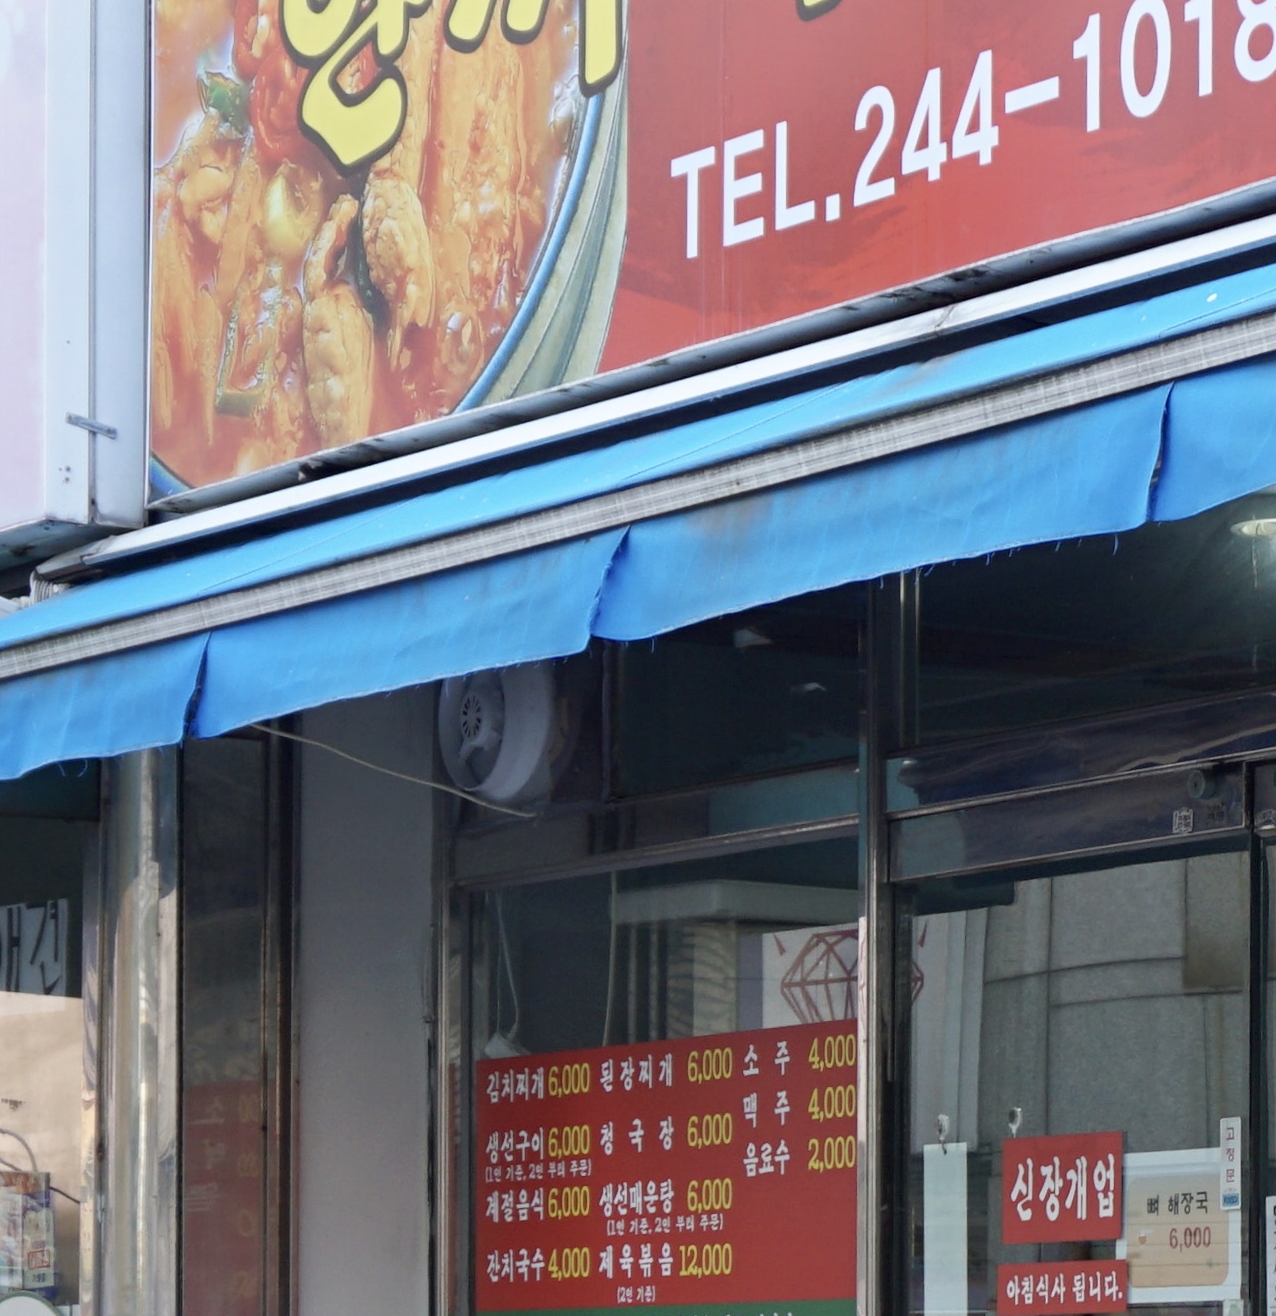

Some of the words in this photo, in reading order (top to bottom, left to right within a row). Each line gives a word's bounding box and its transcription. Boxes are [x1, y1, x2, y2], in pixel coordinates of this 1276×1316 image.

[807, 1033, 856, 1073] 4,000
[486, 1067, 544, 1103] 김치찌개
[547, 1062, 591, 1097] 6,000
[599, 1052, 673, 1093] 된장찌개
[687, 1046, 733, 1084] 6,000
[807, 1084, 856, 1123] 4,000
[485, 1126, 545, 1164] 생선구이
[547, 1124, 591, 1159] 6,000
[687, 1112, 733, 1149] 6,000
[742, 1138, 791, 1177] 음료수
[807, 1135, 856, 1174] 2,000
[1225, 1126, 1236, 1184] 고정문
[485, 1187, 545, 1223] 계절음식
[547, 1185, 591, 1220] 6,000
[598, 1178, 675, 1217] 생선매운탕
[686, 1177, 733, 1214] 6,000
[1010, 1152, 1117, 1222] 신장개업
[1146, 1194, 1160, 1217] 뼈
[1167, 1190, 1210, 1216] 해장국
[1168, 1226, 1212, 1253] 6,000
[486, 1247, 545, 1283] 잔치국수
[547, 1246, 591, 1282] 4,000
[598, 1242, 674, 1279] 제육볶음
[678, 1242, 733, 1279] 12,000
[1006, 1272, 1067, 1306] 아침식사
[1071, 1269, 1124, 1304] 됩니다.
